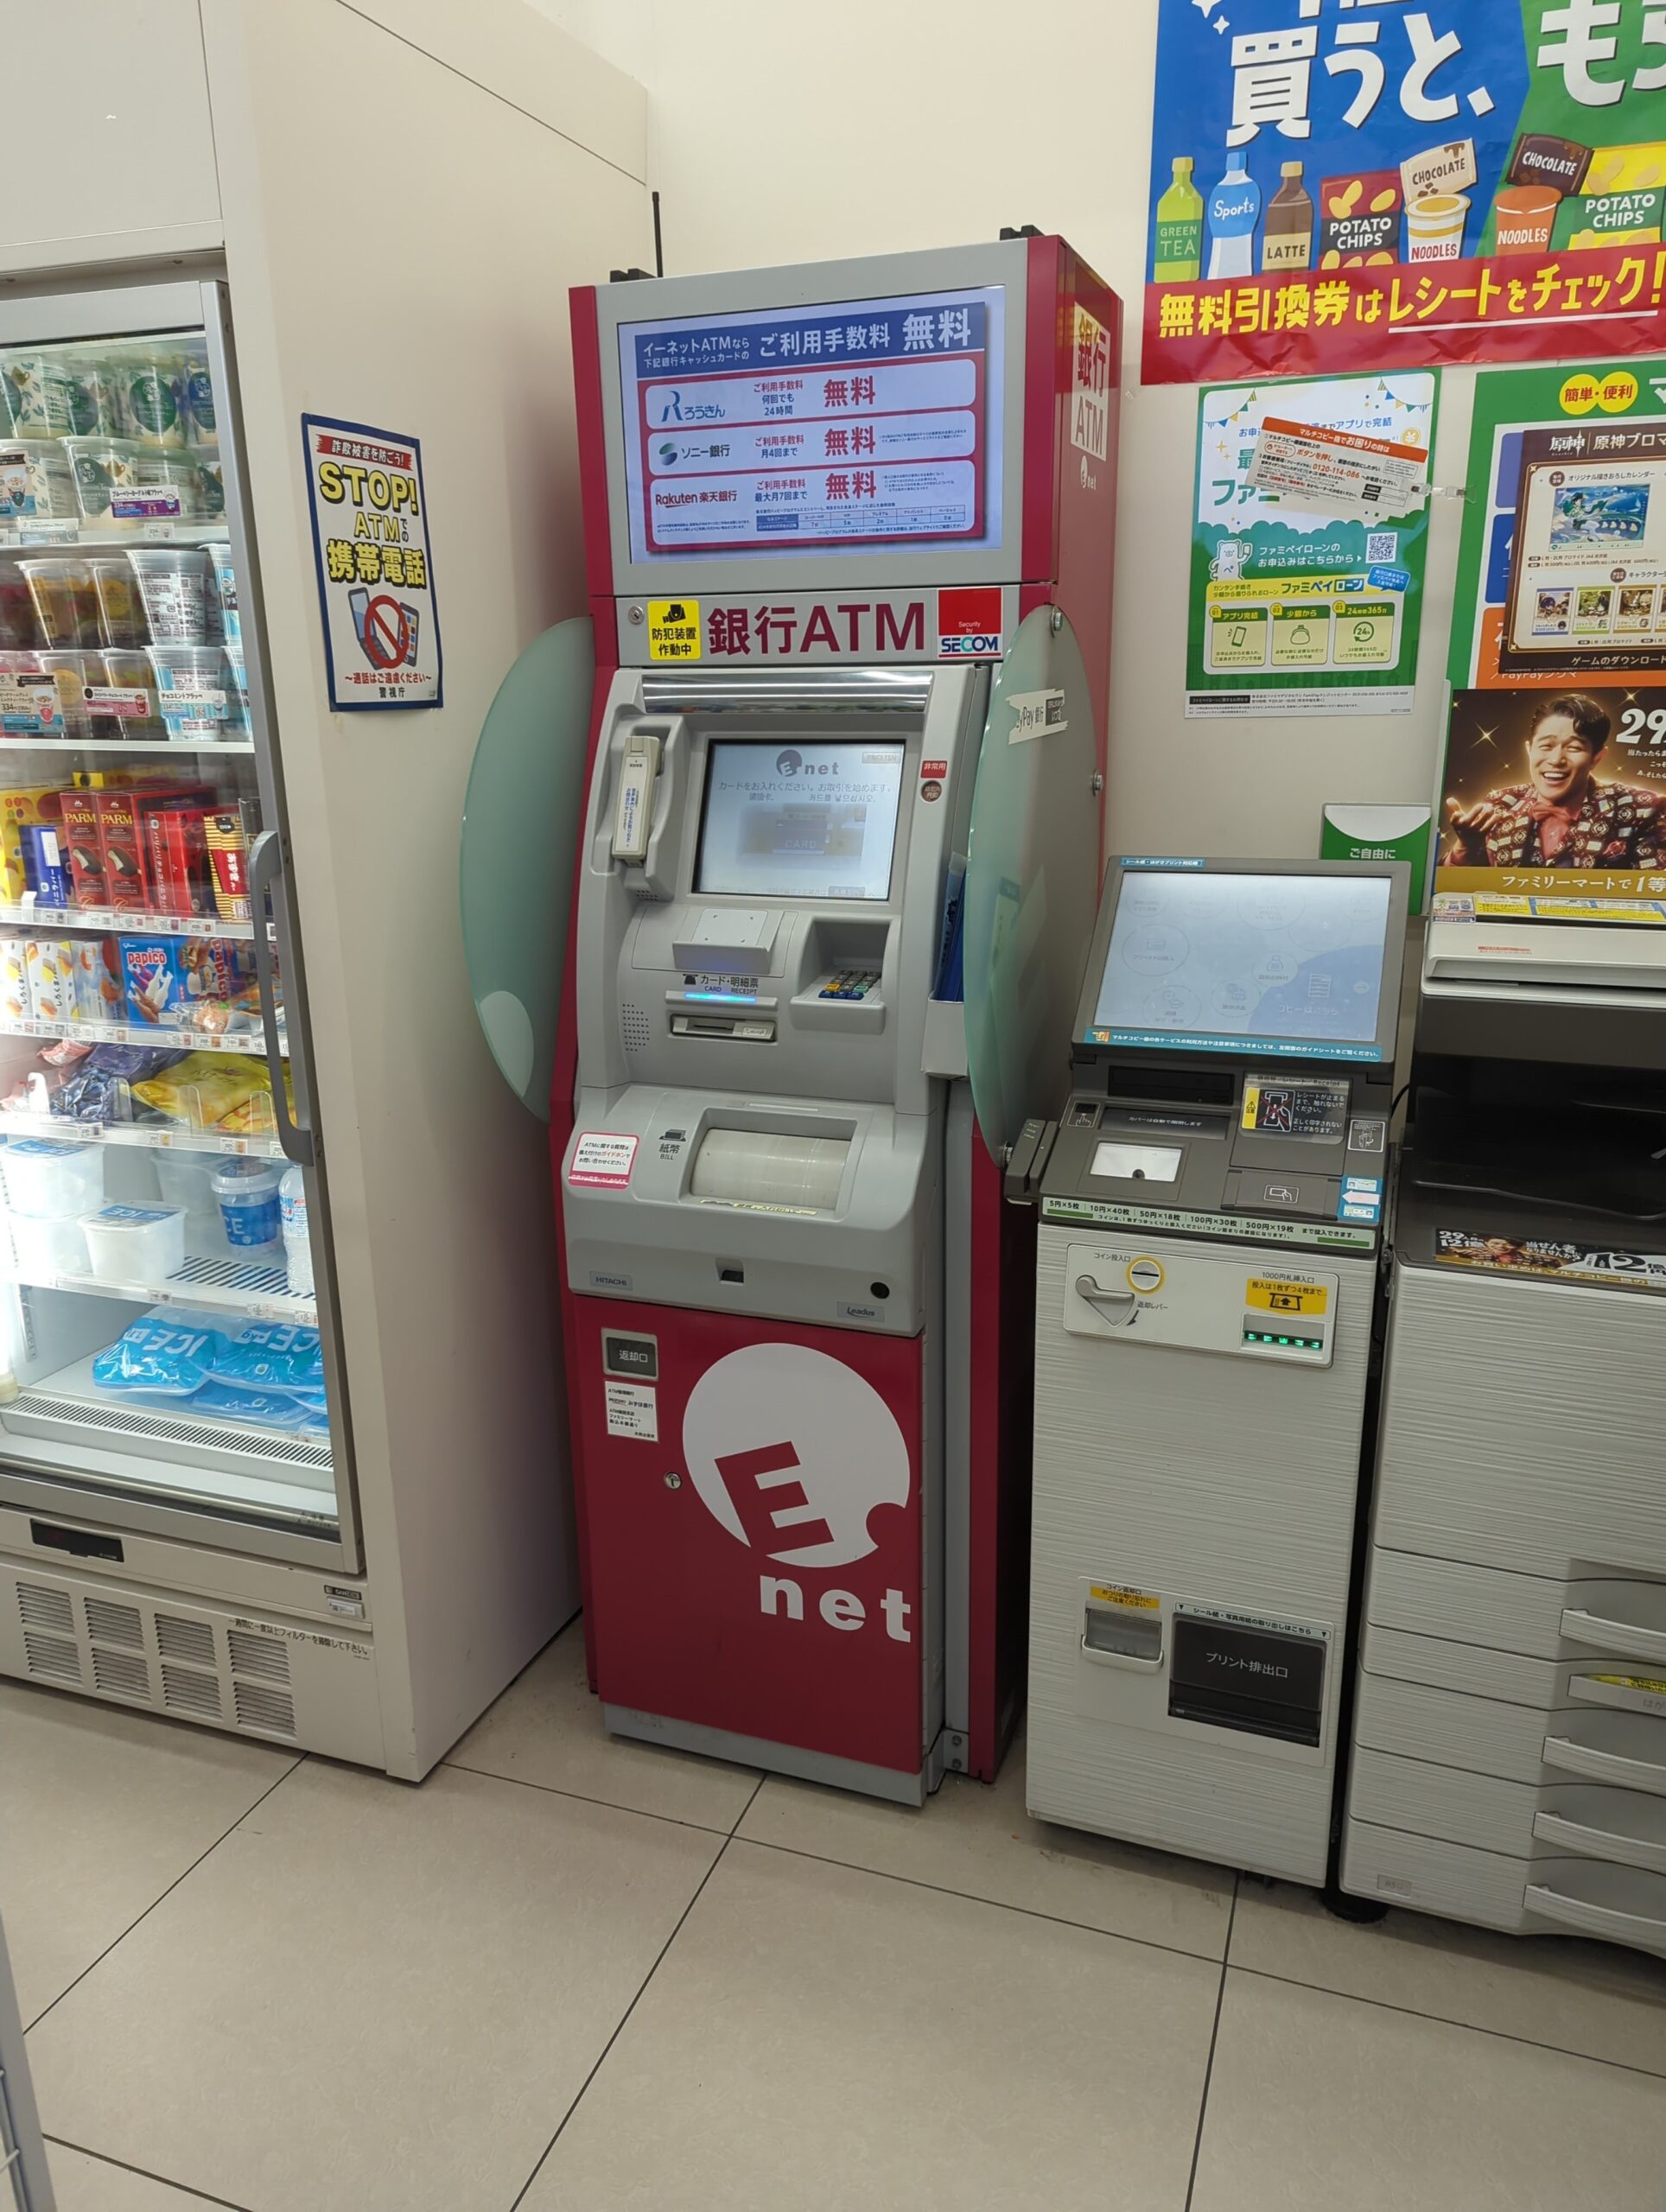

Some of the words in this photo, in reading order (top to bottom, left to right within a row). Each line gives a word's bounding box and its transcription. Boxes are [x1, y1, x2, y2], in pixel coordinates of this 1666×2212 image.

[1227, 13, 1496, 148] 買うと、
[1412, 157, 1466, 186] CHOCOLATE
[1522, 151, 1578, 176] CHOCOLATE
[1213, 199, 1256, 221] Sports
[1585, 194, 1656, 213] POTATO
[1329, 218, 1392, 237] POTATO
[1593, 210, 1644, 229] CHIPS
[1160, 226, 1198, 239] GREEN
[1497, 227, 1548, 245] NOODLES
[1160, 240, 1196, 257] TEA
[1336, 232, 1383, 251] CHIPS
[1267, 242, 1306, 260] LATTE
[1411, 243, 1458, 261] NOODLES
[643, 337, 750, 357] イーネットATMなら
[760, 323, 891, 358] ご利用手数料
[902, 308, 972, 351] 無料
[644, 351, 750, 369] 下記銀行キャッシュカードの
[753, 379, 804, 393] ご利用手数料
[823, 375, 876, 409] 無料
[761, 392, 795, 405] 何回でも
[1564, 385, 1634, 403] 簡単・便利
[684, 404, 726, 421] ろうきん
[764, 404, 793, 416] 24時間
[1075, 396, 1103, 456] ATM
[754, 434, 804, 448] ご利用手数料
[823, 425, 876, 457] 無料
[331, 439, 404, 467] 詐欺被害を防ごう!
[681, 443, 731, 460] ソニー銀行
[760, 446, 798, 459] 月4回まで
[1313, 463, 1360, 479] 0120-114-086
[318, 461, 420, 516] STOP!
[756, 478, 806, 492] ご利用手数料
[824, 470, 877, 501] 無料
[655, 491, 698, 507] Rakuten
[699, 489, 738, 504] 楽天銀行
[754, 489, 808, 503] 最大月7回まで
[1259, 543, 1340, 556] ファミペイローンの
[326, 538, 427, 588] 携帯電話
[1258, 554, 1354, 568] お申込みはこちらから
[1281, 578, 1364, 594] ファミペイローン
[707, 602, 925, 656] 銀行ATM
[958, 621, 982, 630] Security
[652, 626, 697, 642] 防犯装置
[658, 642, 692, 657] 作動中
[940, 636, 999, 654] SECOM
[378, 686, 406, 699] 警視庁
[804, 761, 839, 775] net
[65, 813, 97, 823] PARM
[100, 814, 133, 824] PARM
[1350, 848, 1396, 860] ご自由に
[127, 949, 167, 965] papico
[700, 974, 759, 988] カード・明細票
[704, 985, 722, 994] CARD
[1296, 1098, 1345, 1109] まで、触れないで
[1297, 1091, 1345, 1102] レシートが止まる
[1295, 1105, 1322, 1114] ください。
[1293, 1119, 1342, 1128] 正しく印字されない
[1293, 1125, 1334, 1135] ことがあります。
[658, 1143, 681, 1154] 紙幣
[1050, 1199, 1079, 1210] 5円×5枚
[1090, 1205, 1130, 1216] 10円×40枚
[1140, 1211, 1180, 1222] 50円×18枚
[1191, 1216, 1237, 1227] 100円×30枚
[1246, 1221, 1294, 1233] 500円×19枚
[1302, 1228, 1356, 1238] まで投入できます。
[1094, 1253, 1131, 1263] コイン投入口
[595, 1275, 626, 1287] HITACHI
[1262, 1271, 1315, 1284] 1000円札挿入口
[1251, 1281, 1323, 1296] 投入は1枚ずつ4枚まで
[847, 1306, 875, 1319] Leadus
[1137, 1300, 1168, 1311] 返却レバー
[619, 1349, 649, 1363] 返却口
[760, 1574, 912, 1643] net
[1192, 1607, 1313, 1636] シール紙・写真用紙の取り出しはこちら
[1205, 1651, 1288, 1679] プリント排出口
